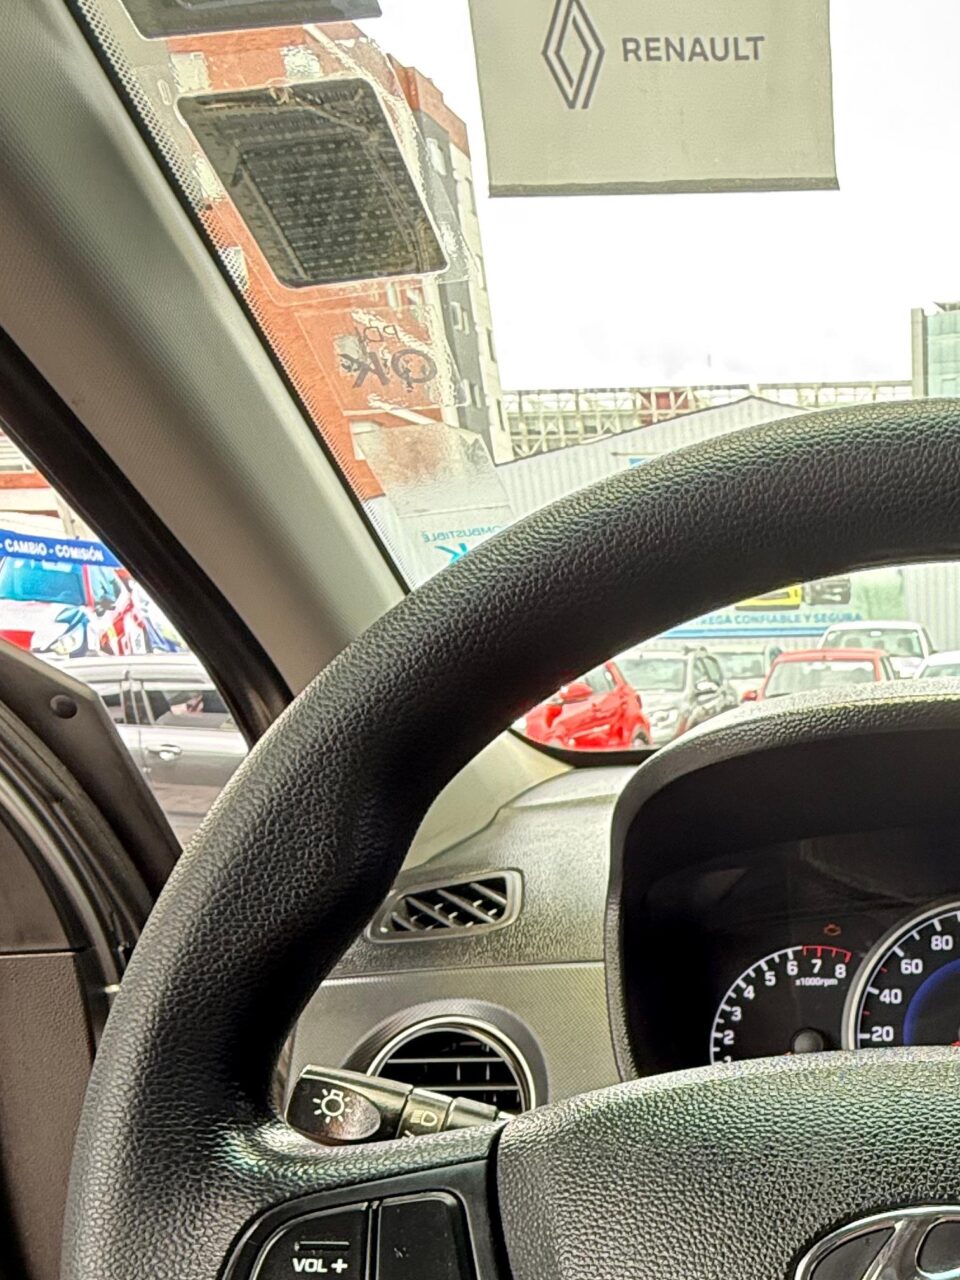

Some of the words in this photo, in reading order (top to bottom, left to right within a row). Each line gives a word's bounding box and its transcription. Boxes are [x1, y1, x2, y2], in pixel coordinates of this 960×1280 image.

[622, 36, 765, 62] RENAULT
[4, 538, 48, 557] CAMBIO
[55, 544, 105, 562] COMISIÓN
[735, 613, 800, 624] CONFIABLE
[814, 612, 863, 623] SEGURA
[931, 935, 953, 951] 80
[786, 961, 798, 976] 6
[811, 959, 822, 974] 7
[835, 964, 846, 979] 8
[900, 959, 923, 975] 60
[765, 971, 776, 986] 5
[743, 985, 755, 1000] 4
[879, 988, 902, 1004] 40
[731, 1006, 742, 1021] 3
[723, 1030, 735, 1045] 2
[871, 1026, 894, 1042] 20
[292, 1258, 328, 1273] VOL
